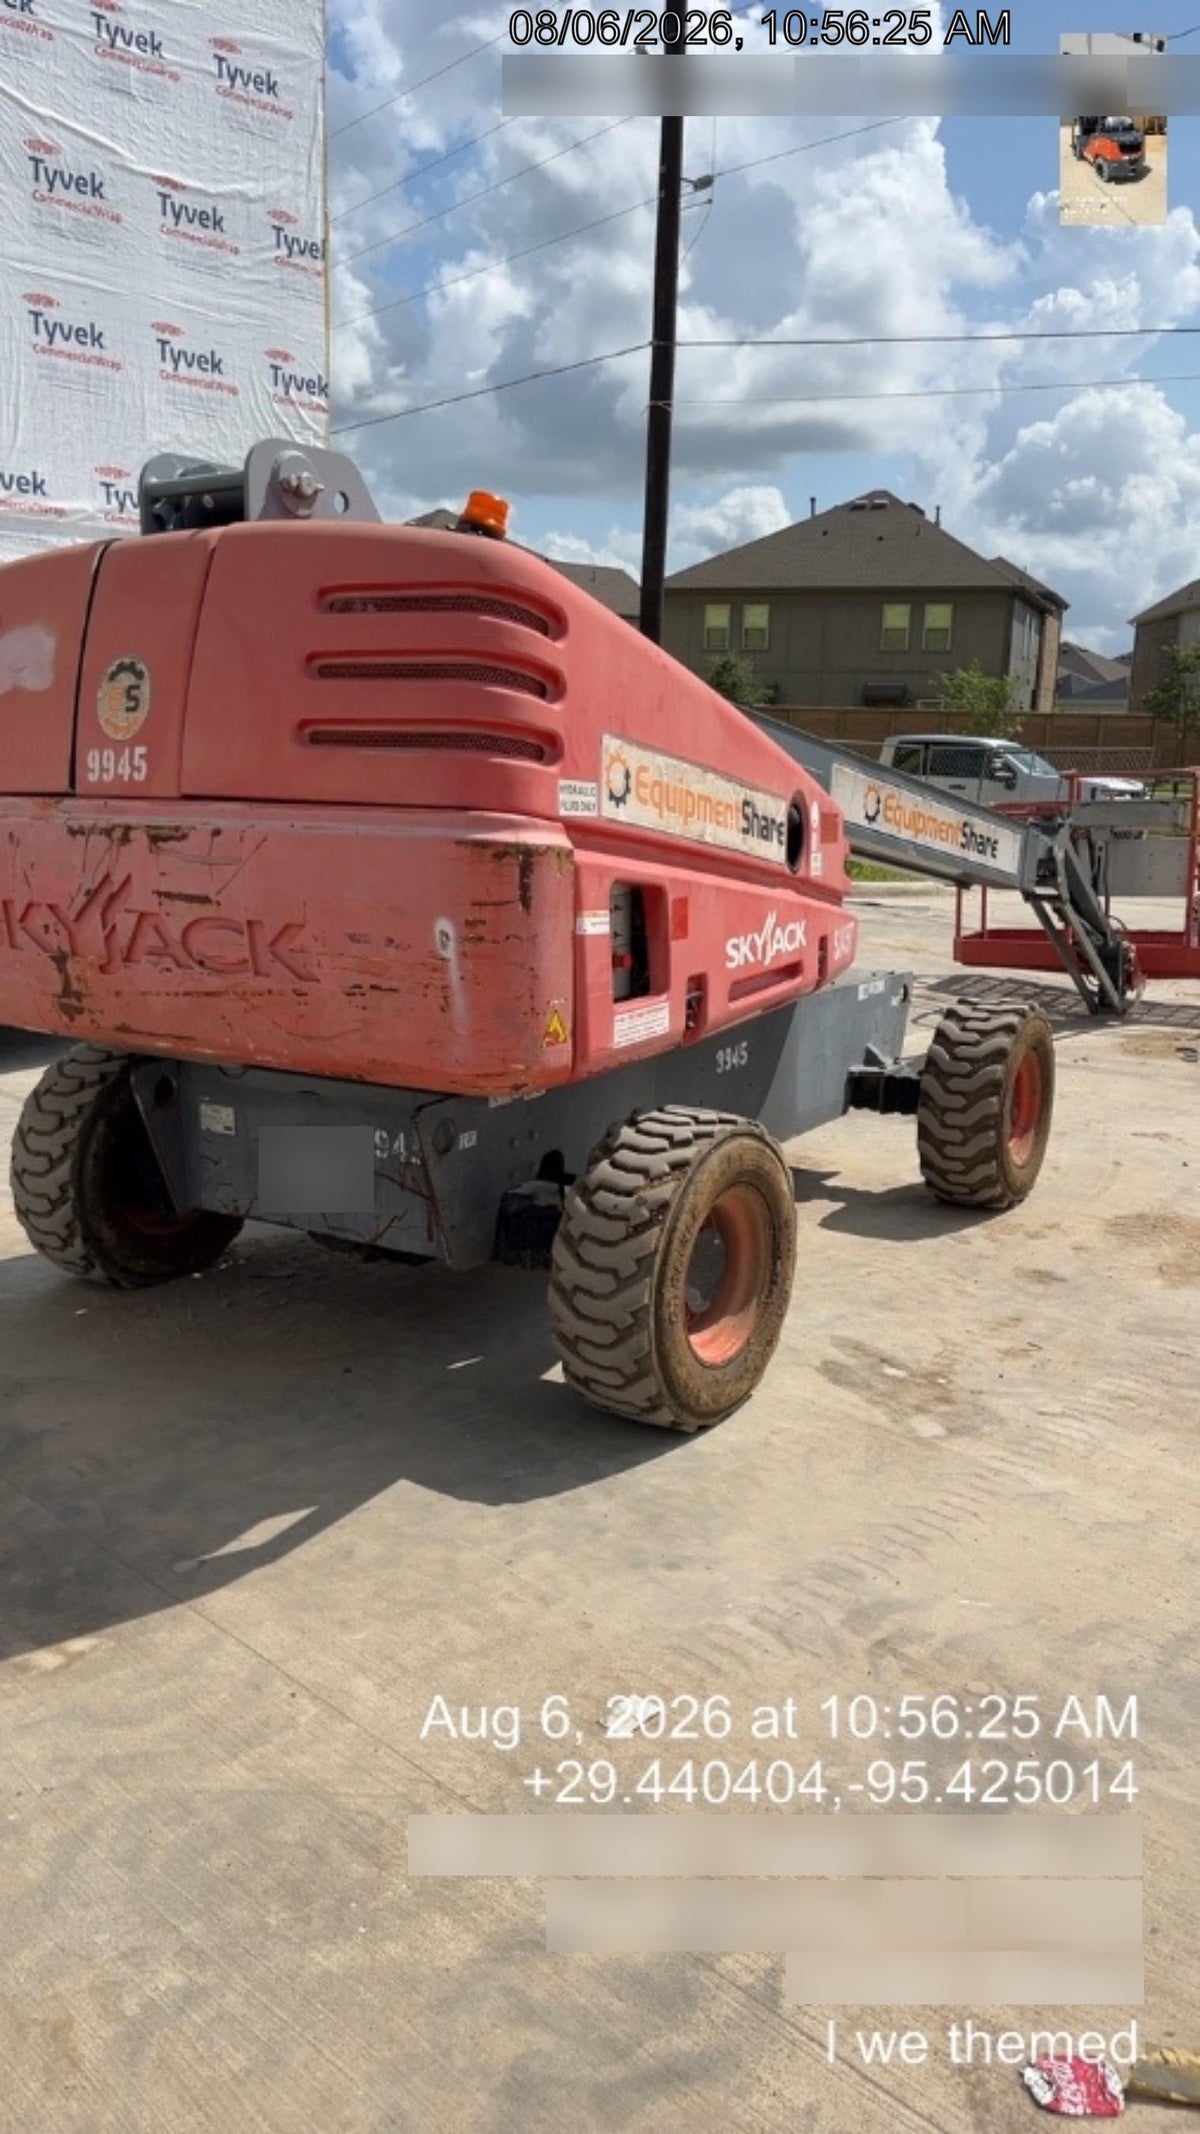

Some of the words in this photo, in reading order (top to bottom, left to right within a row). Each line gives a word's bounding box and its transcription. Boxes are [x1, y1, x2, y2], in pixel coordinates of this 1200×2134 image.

[91, 11, 165, 59] Tyvek
[213, 53, 279, 98] Tyvek
[28, 156, 107, 200] Tyvek
[157, 192, 226, 233] Tyvek
[27, 310, 105, 349] Tyvek
[156, 338, 224, 375] Tyvek
[270, 364, 330, 398] Tyvek
[87, 746, 148, 782] 9945
[635, 764, 787, 847] EquipmentShare
[883, 792, 999, 860] EquipmentShare
[725, 909, 807, 969] SKYJACK
